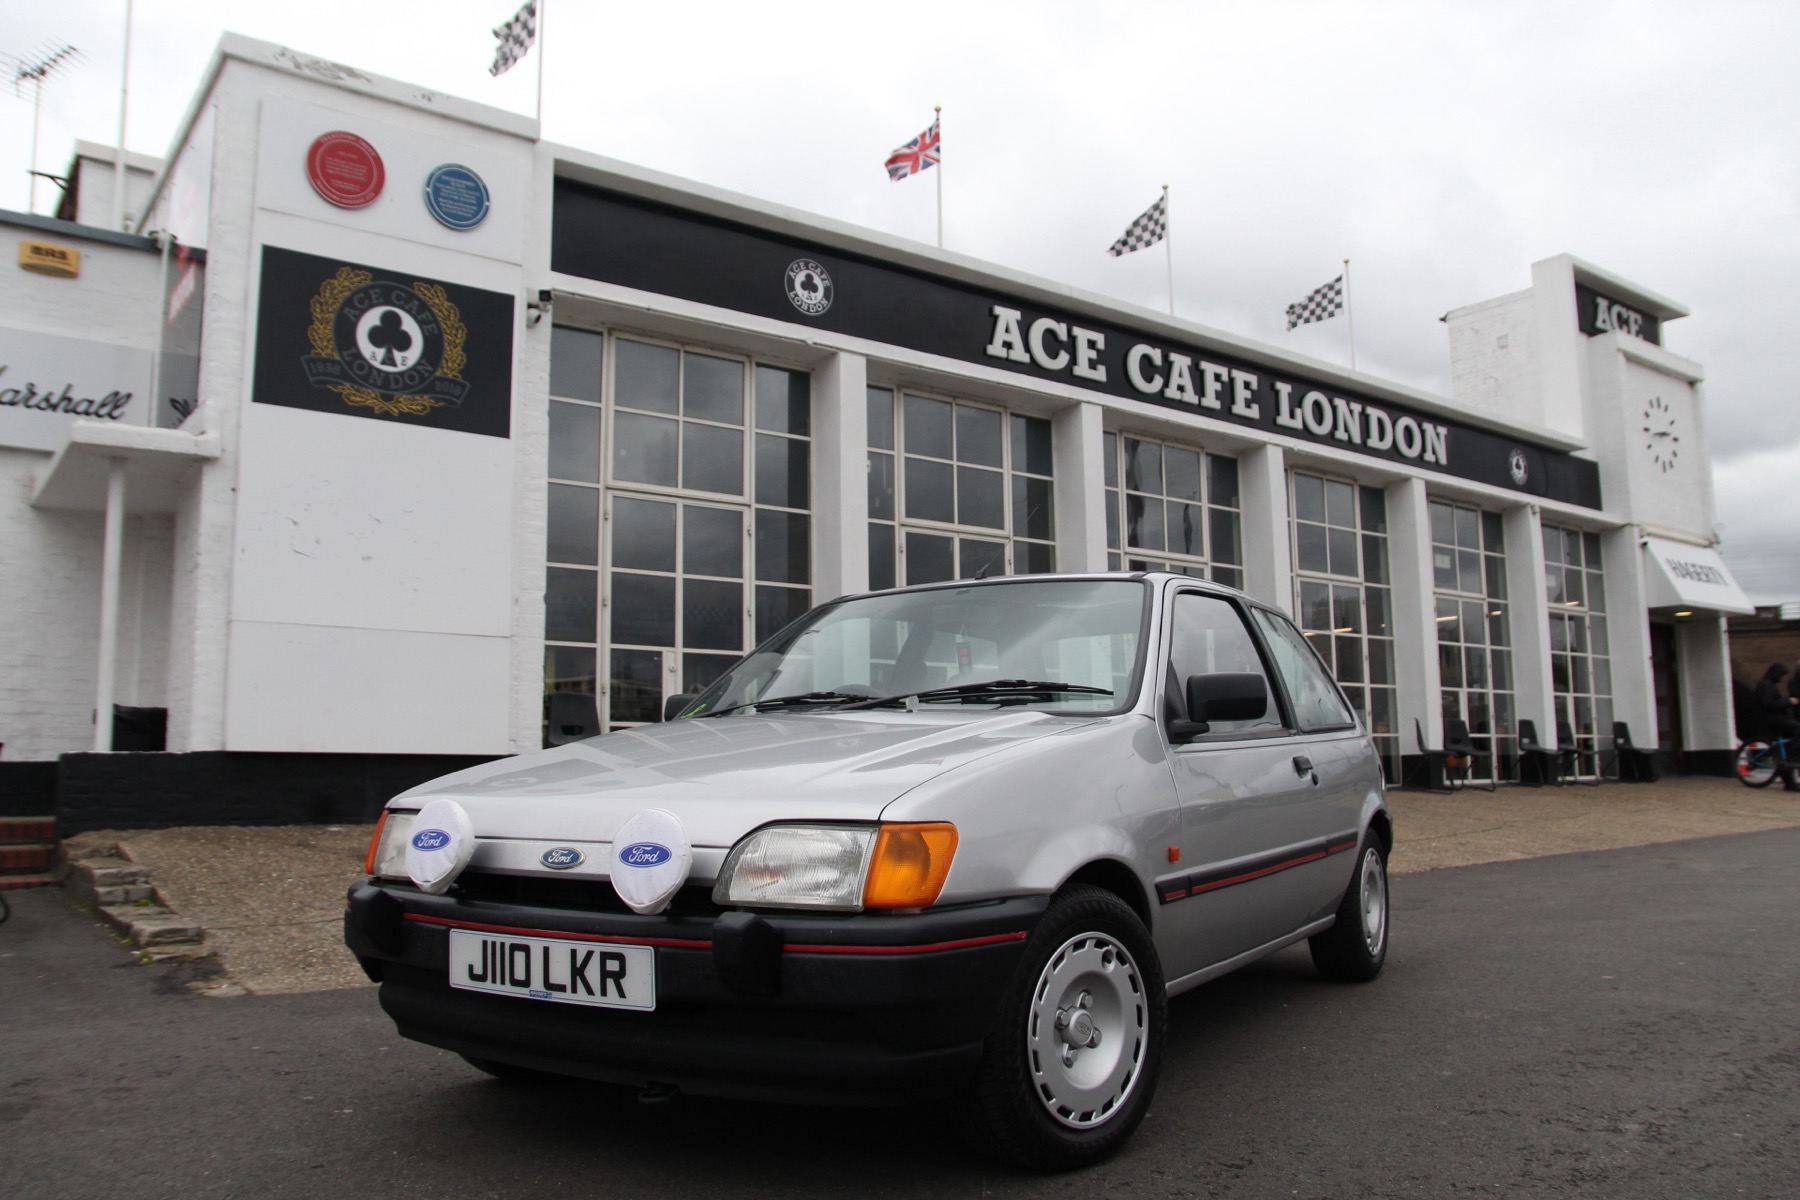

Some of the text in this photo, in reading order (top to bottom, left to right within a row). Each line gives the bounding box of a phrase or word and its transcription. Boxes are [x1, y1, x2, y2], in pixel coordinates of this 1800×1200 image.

[343, 288, 438, 336] ACE CAFE
[1595, 296, 1643, 340] ACE
[342, 347, 434, 389] LONDON
[986, 305, 1448, 466] ACE CAFE LONDON
[0, 366, 133, 420] arshall
[417, 832, 442, 848] Ford
[547, 849, 573, 864] Ford
[628, 846, 660, 863] Ford
[543, 946, 628, 999] LKR
